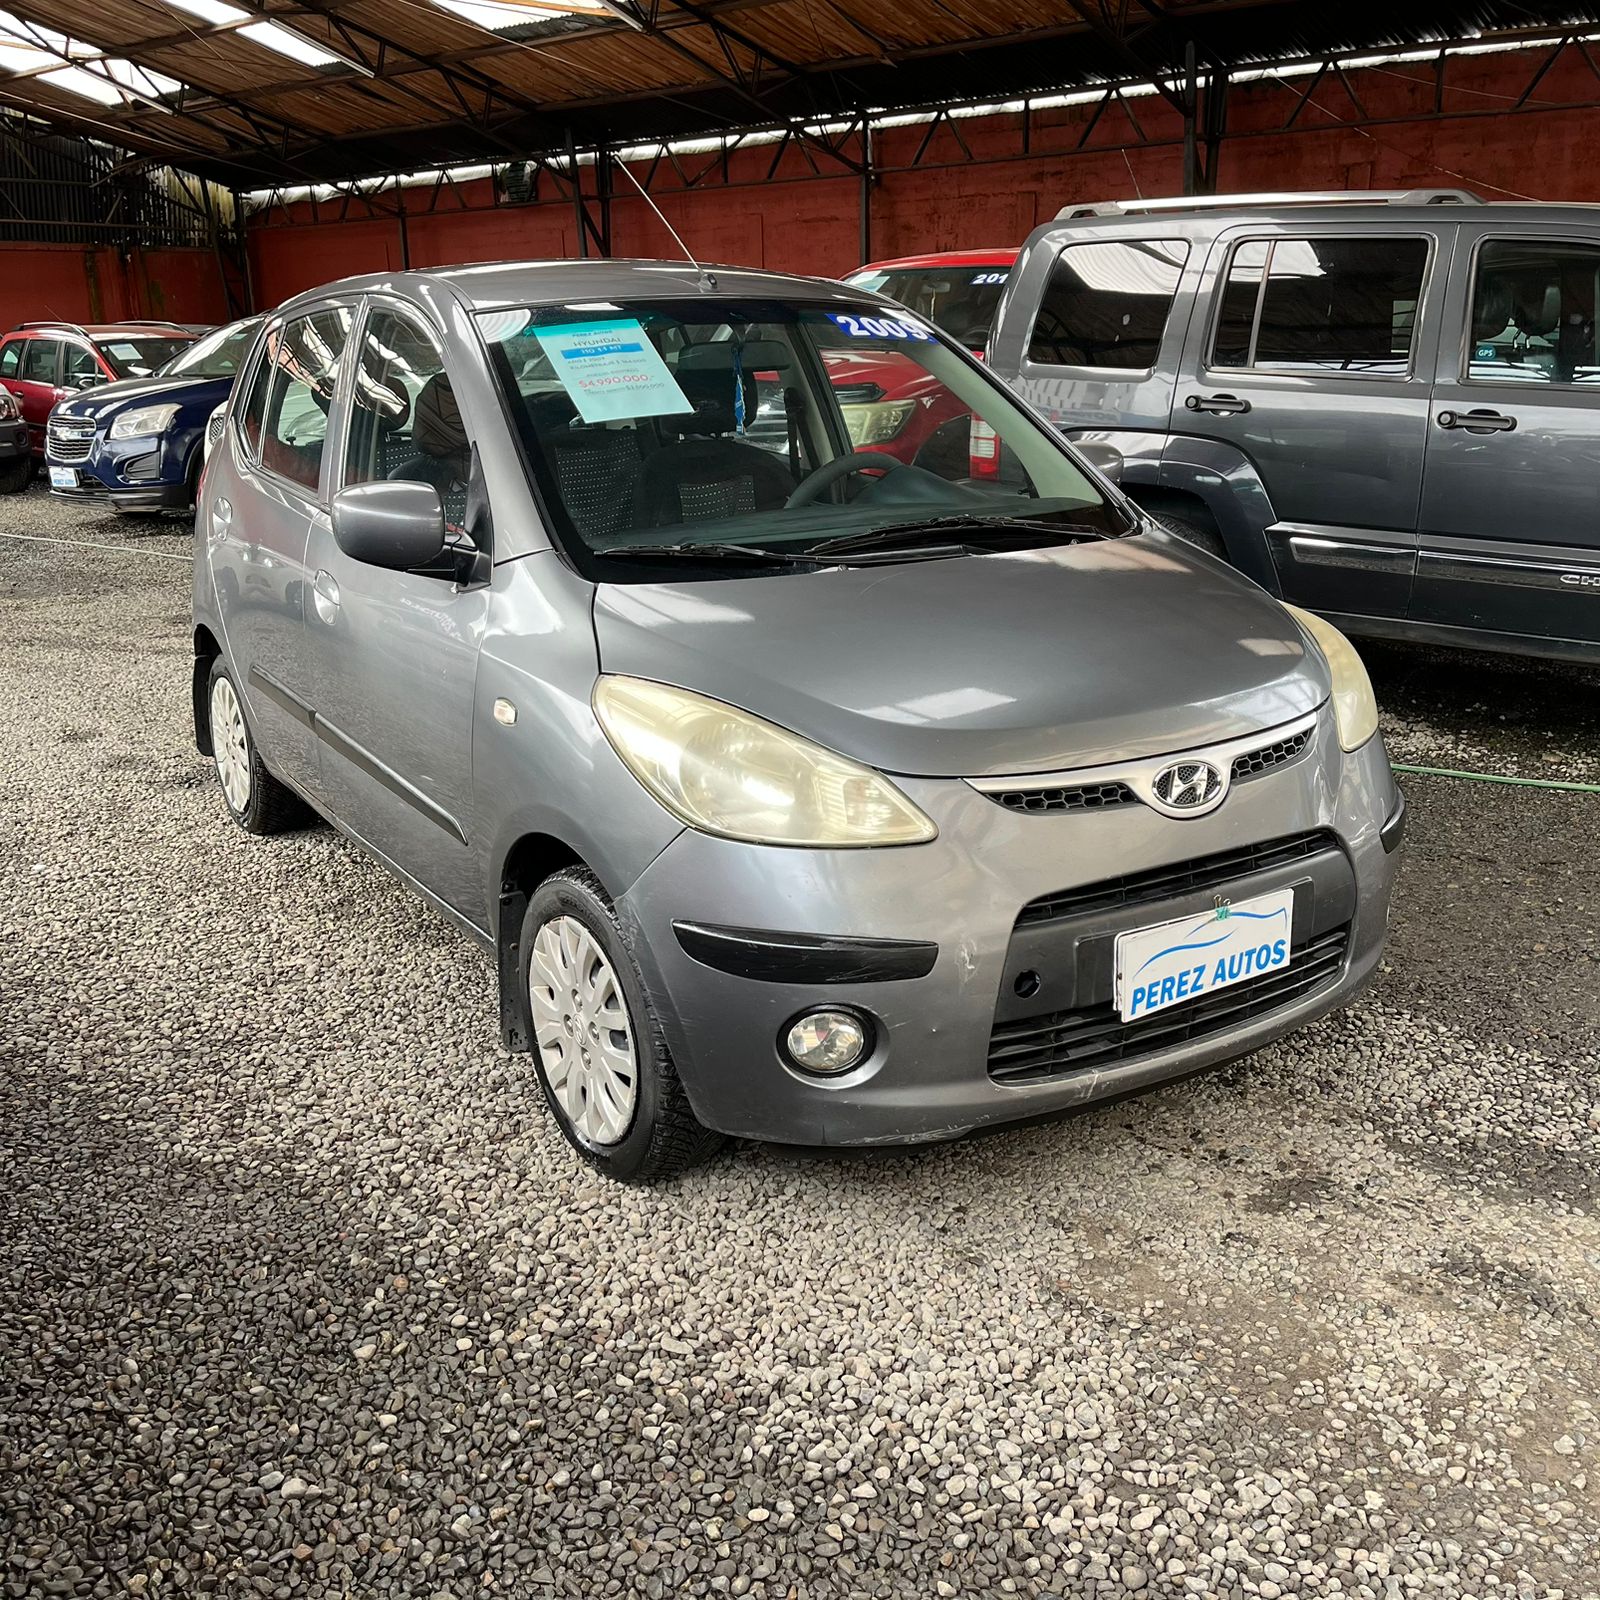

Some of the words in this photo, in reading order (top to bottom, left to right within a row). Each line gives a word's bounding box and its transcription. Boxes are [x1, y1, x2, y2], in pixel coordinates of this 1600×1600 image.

[836, 315, 929, 340] 2009
[573, 337, 622, 347] HYUNDAI
[1478, 349, 1493, 357] GPS
[1131, 964, 1206, 1016] PEREZ
[1211, 938, 1286, 986] AUTOS
